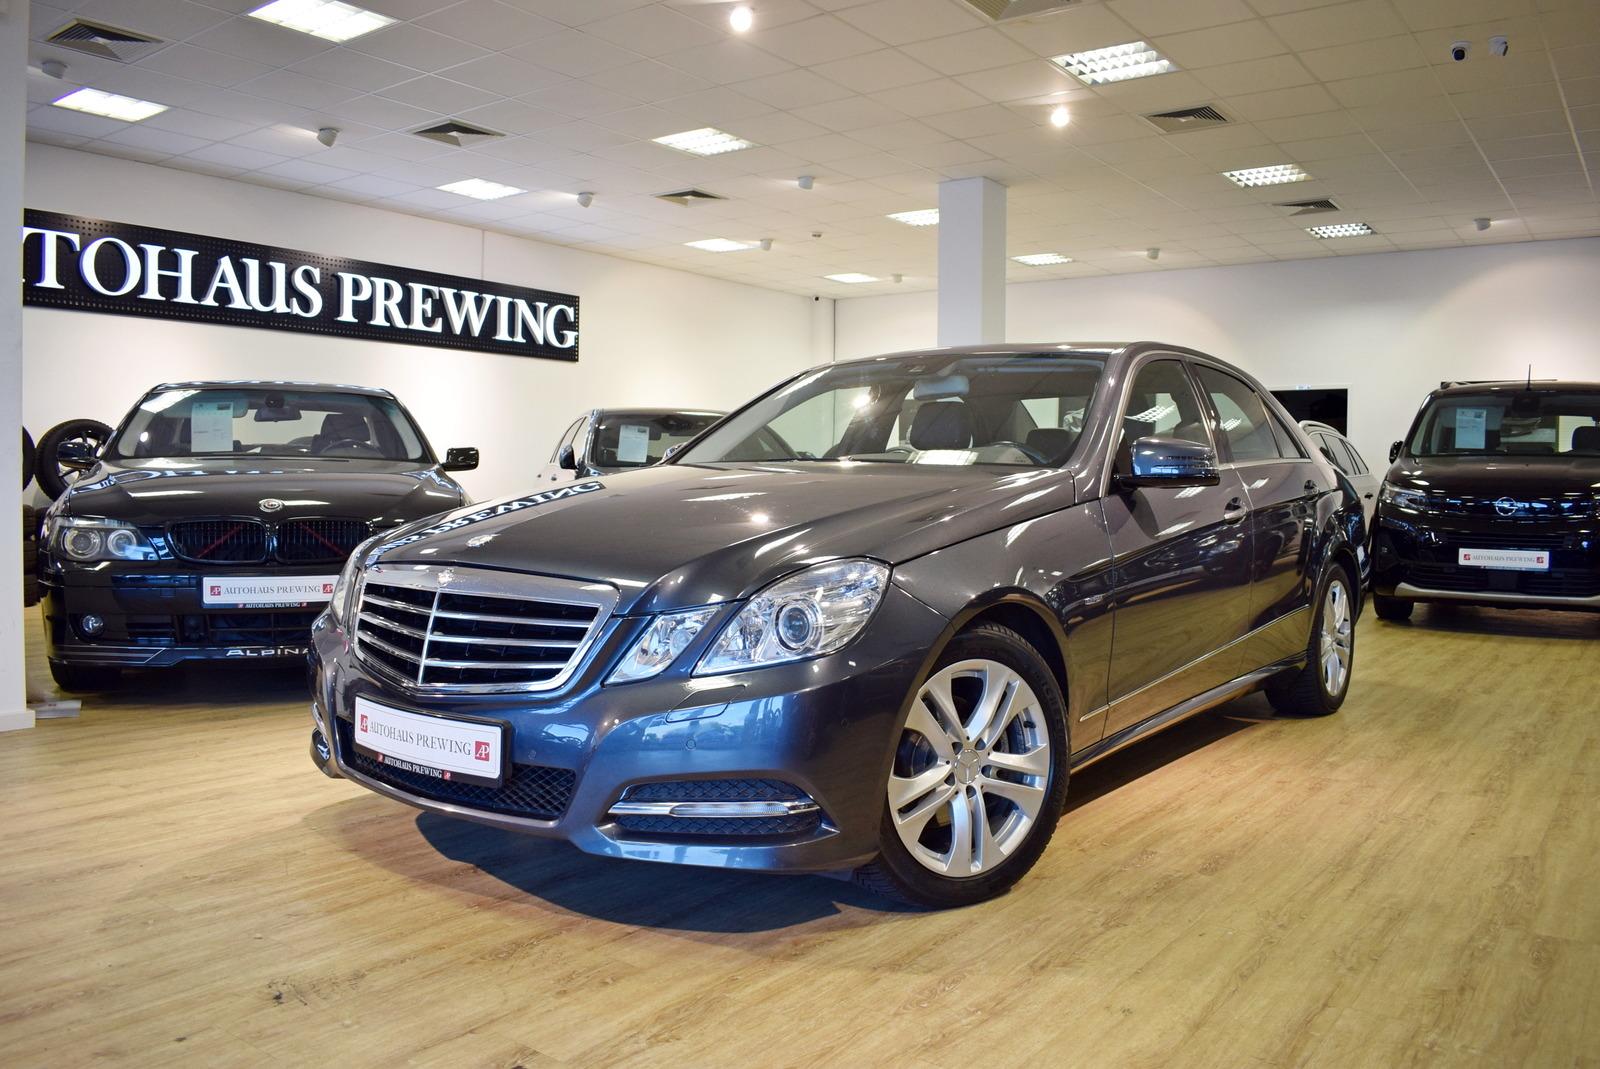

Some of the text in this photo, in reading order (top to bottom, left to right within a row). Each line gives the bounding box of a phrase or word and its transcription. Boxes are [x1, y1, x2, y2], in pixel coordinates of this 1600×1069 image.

[22, 226, 578, 349] TOHAUS PREWING
[224, 585, 275, 594] AUTOHAUS
[276, 584, 321, 594] PREWING
[369, 721, 414, 744] AUTOHAUS
[416, 733, 472, 756] PREWING
[384, 757, 412, 771] AUTOHAUS
[412, 764, 442, 778] PREWING
